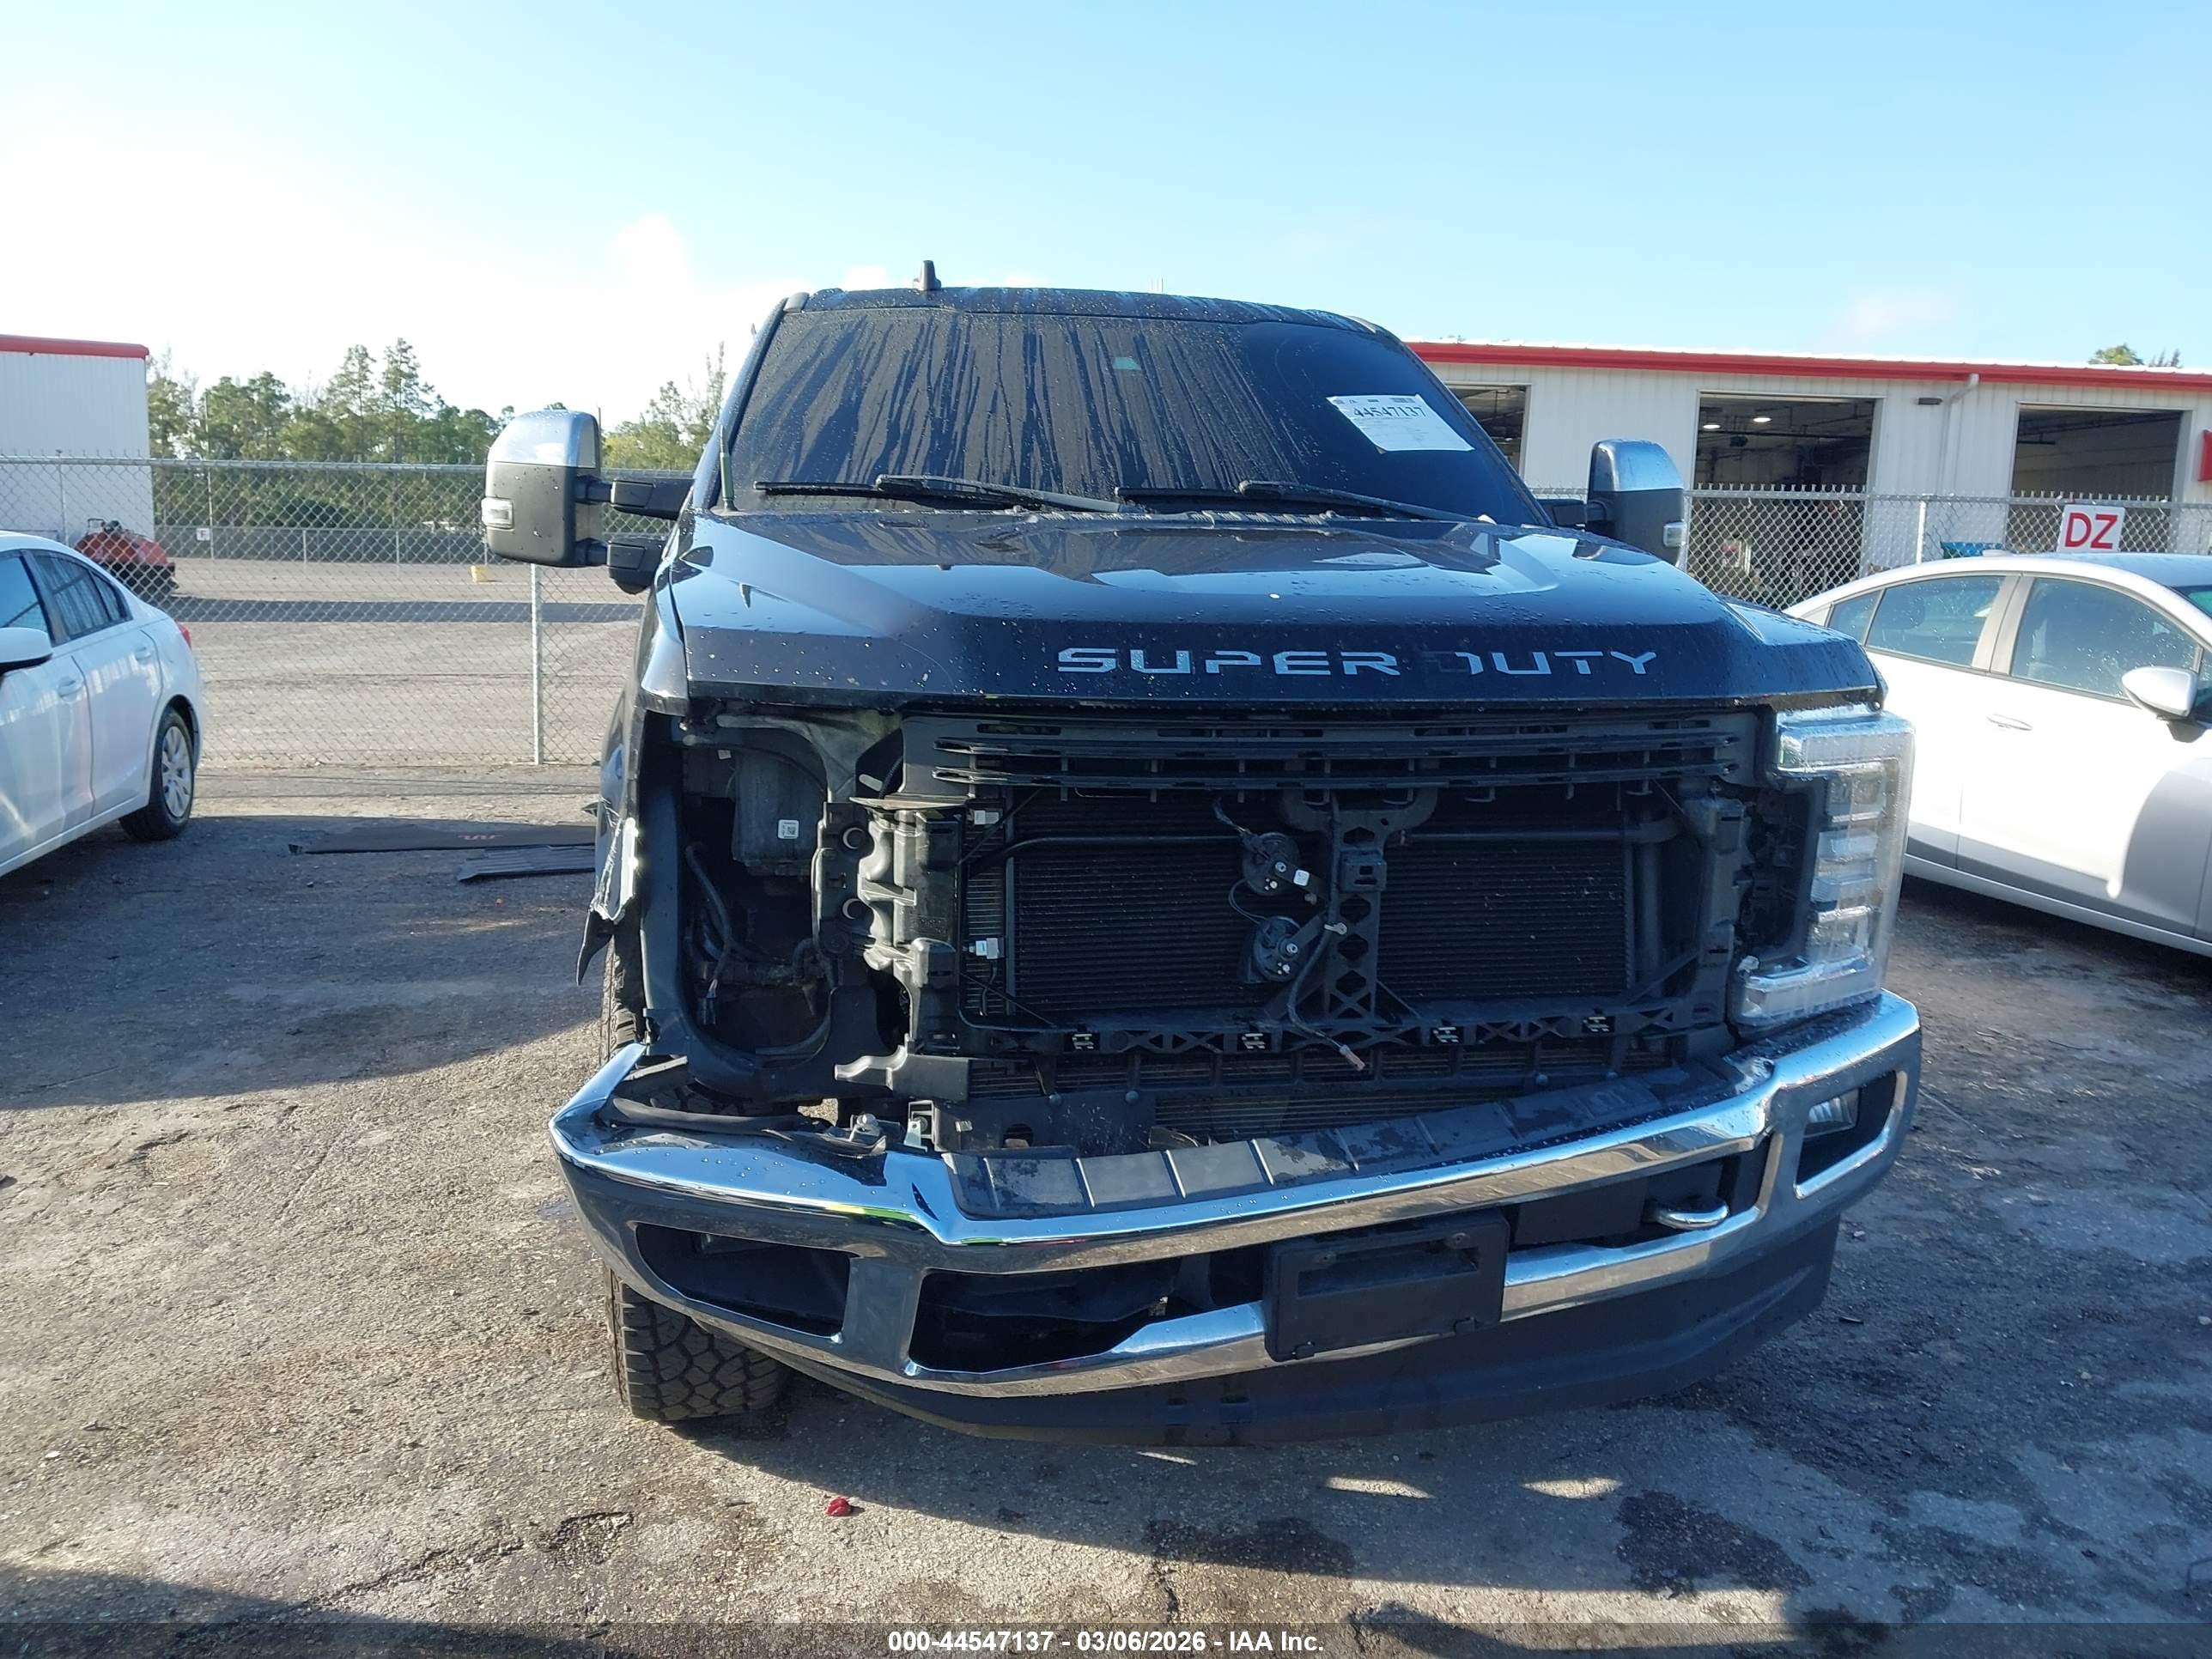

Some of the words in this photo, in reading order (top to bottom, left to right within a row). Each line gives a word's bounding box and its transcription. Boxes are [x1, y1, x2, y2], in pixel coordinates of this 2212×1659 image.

[1353, 405, 1427, 418] 44547137
[2064, 513, 2118, 550] DZ
[1057, 647, 1401, 676] SUPER
